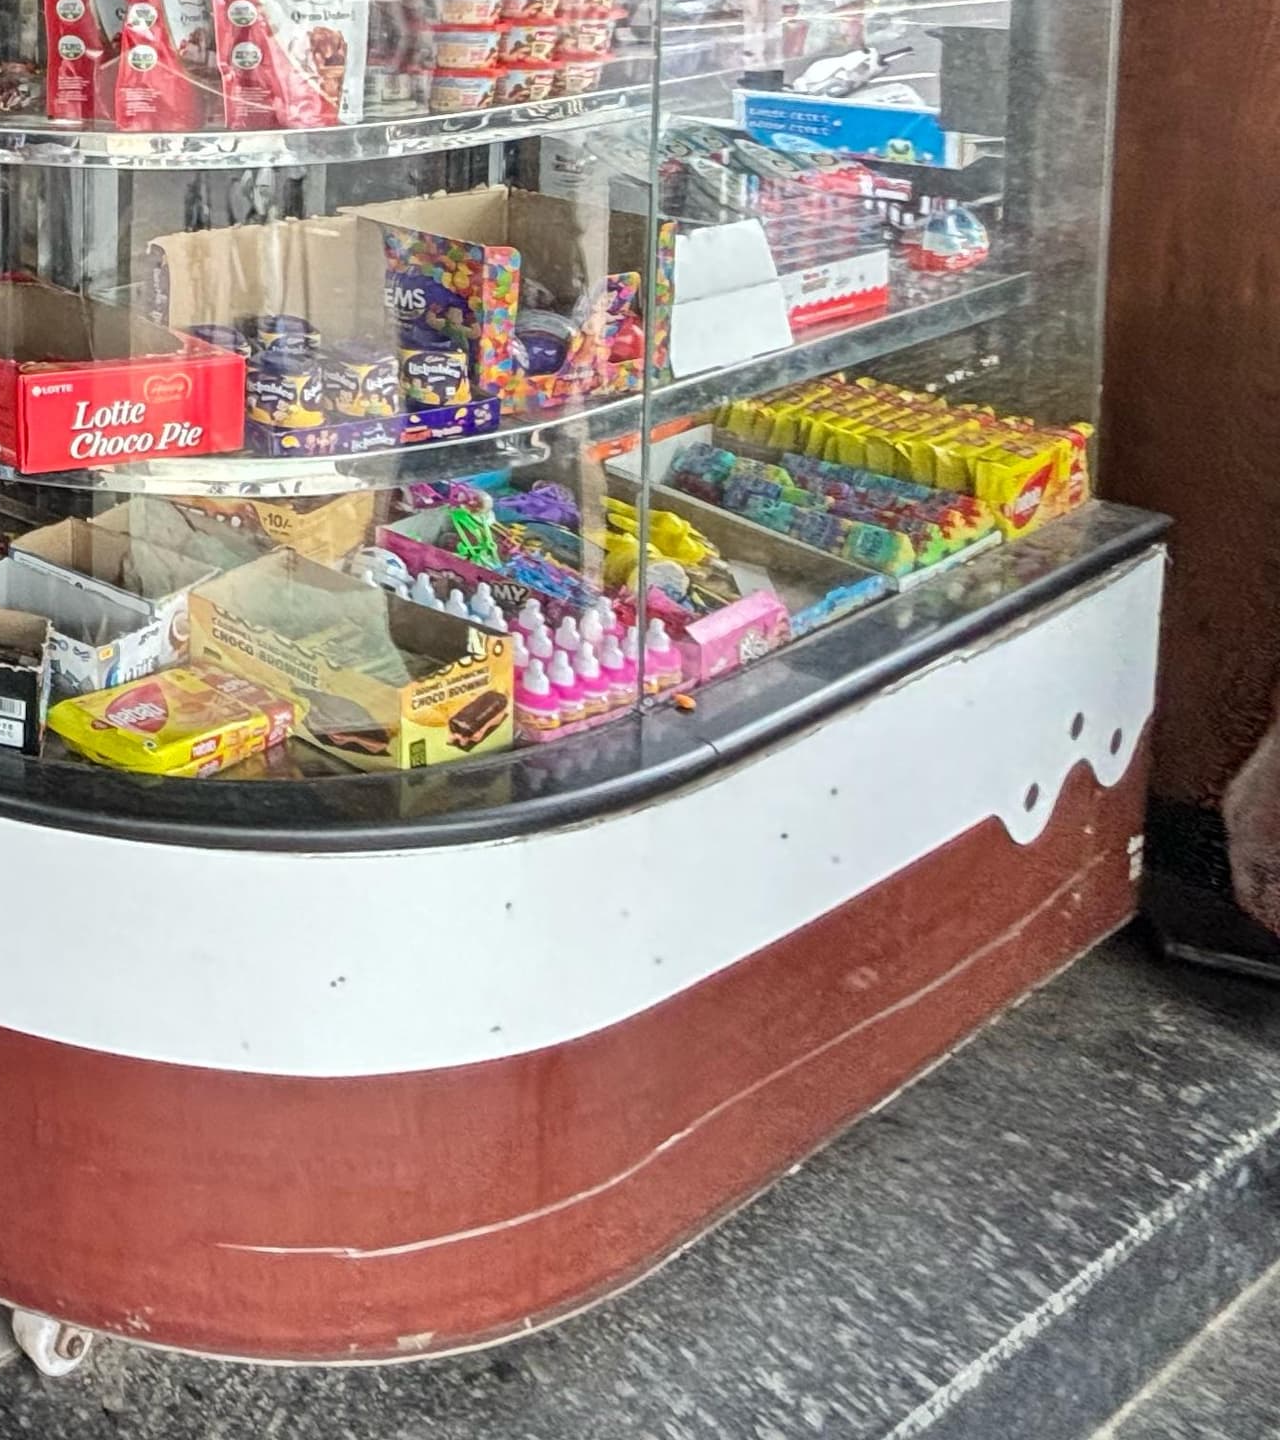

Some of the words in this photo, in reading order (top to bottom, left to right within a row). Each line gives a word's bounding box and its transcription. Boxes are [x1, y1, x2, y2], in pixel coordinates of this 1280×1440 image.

[384, 287, 426, 310] EMS
[42, 384, 74, 394] LOTTE
[71, 399, 146, 431] Lotte
[70, 432, 156, 461] Choco
[154, 421, 204, 451] Pie
